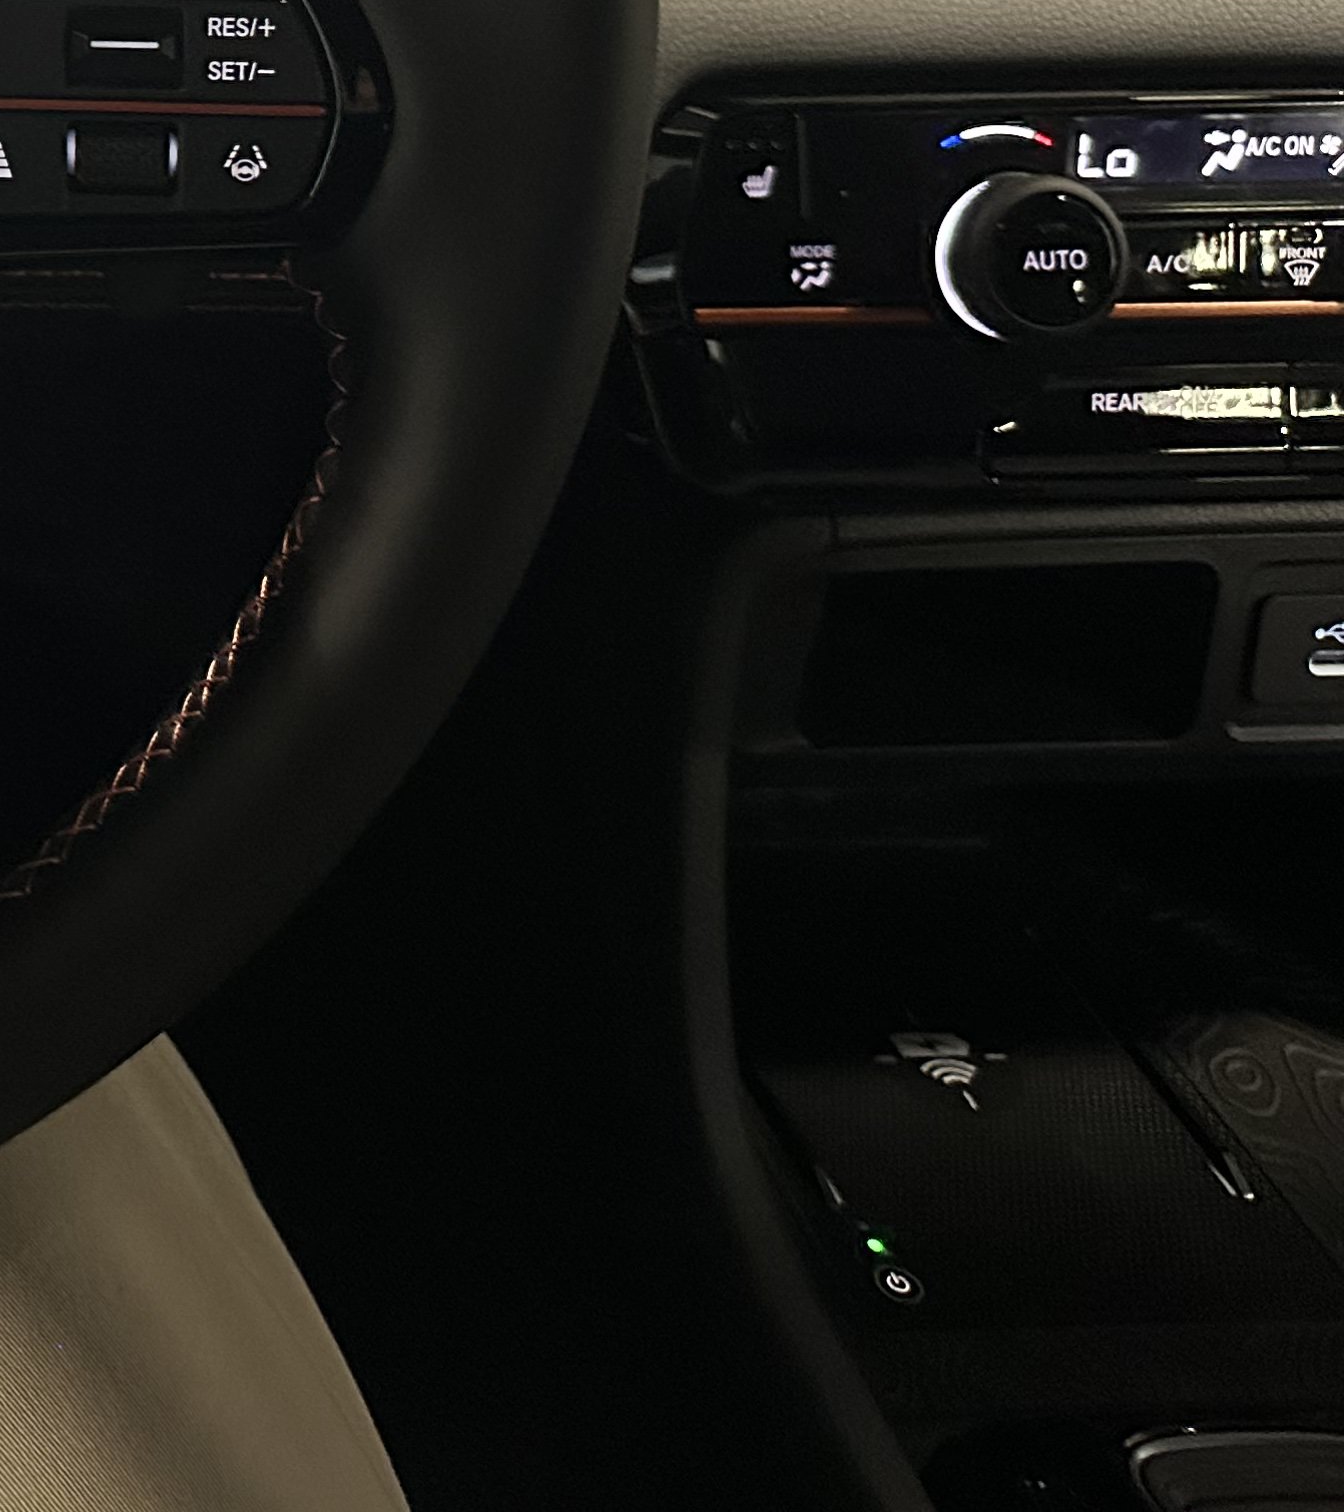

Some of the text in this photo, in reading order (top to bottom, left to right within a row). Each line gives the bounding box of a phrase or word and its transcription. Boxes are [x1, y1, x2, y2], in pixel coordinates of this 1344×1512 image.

[207, 17, 276, 39] RES/+
[1244, 135, 1315, 157] A/C ON
[789, 244, 837, 259] MODE
[1022, 249, 1088, 271] AUTO
[1146, 254, 1190, 274] A/C
[1090, 392, 1146, 414] REAR
